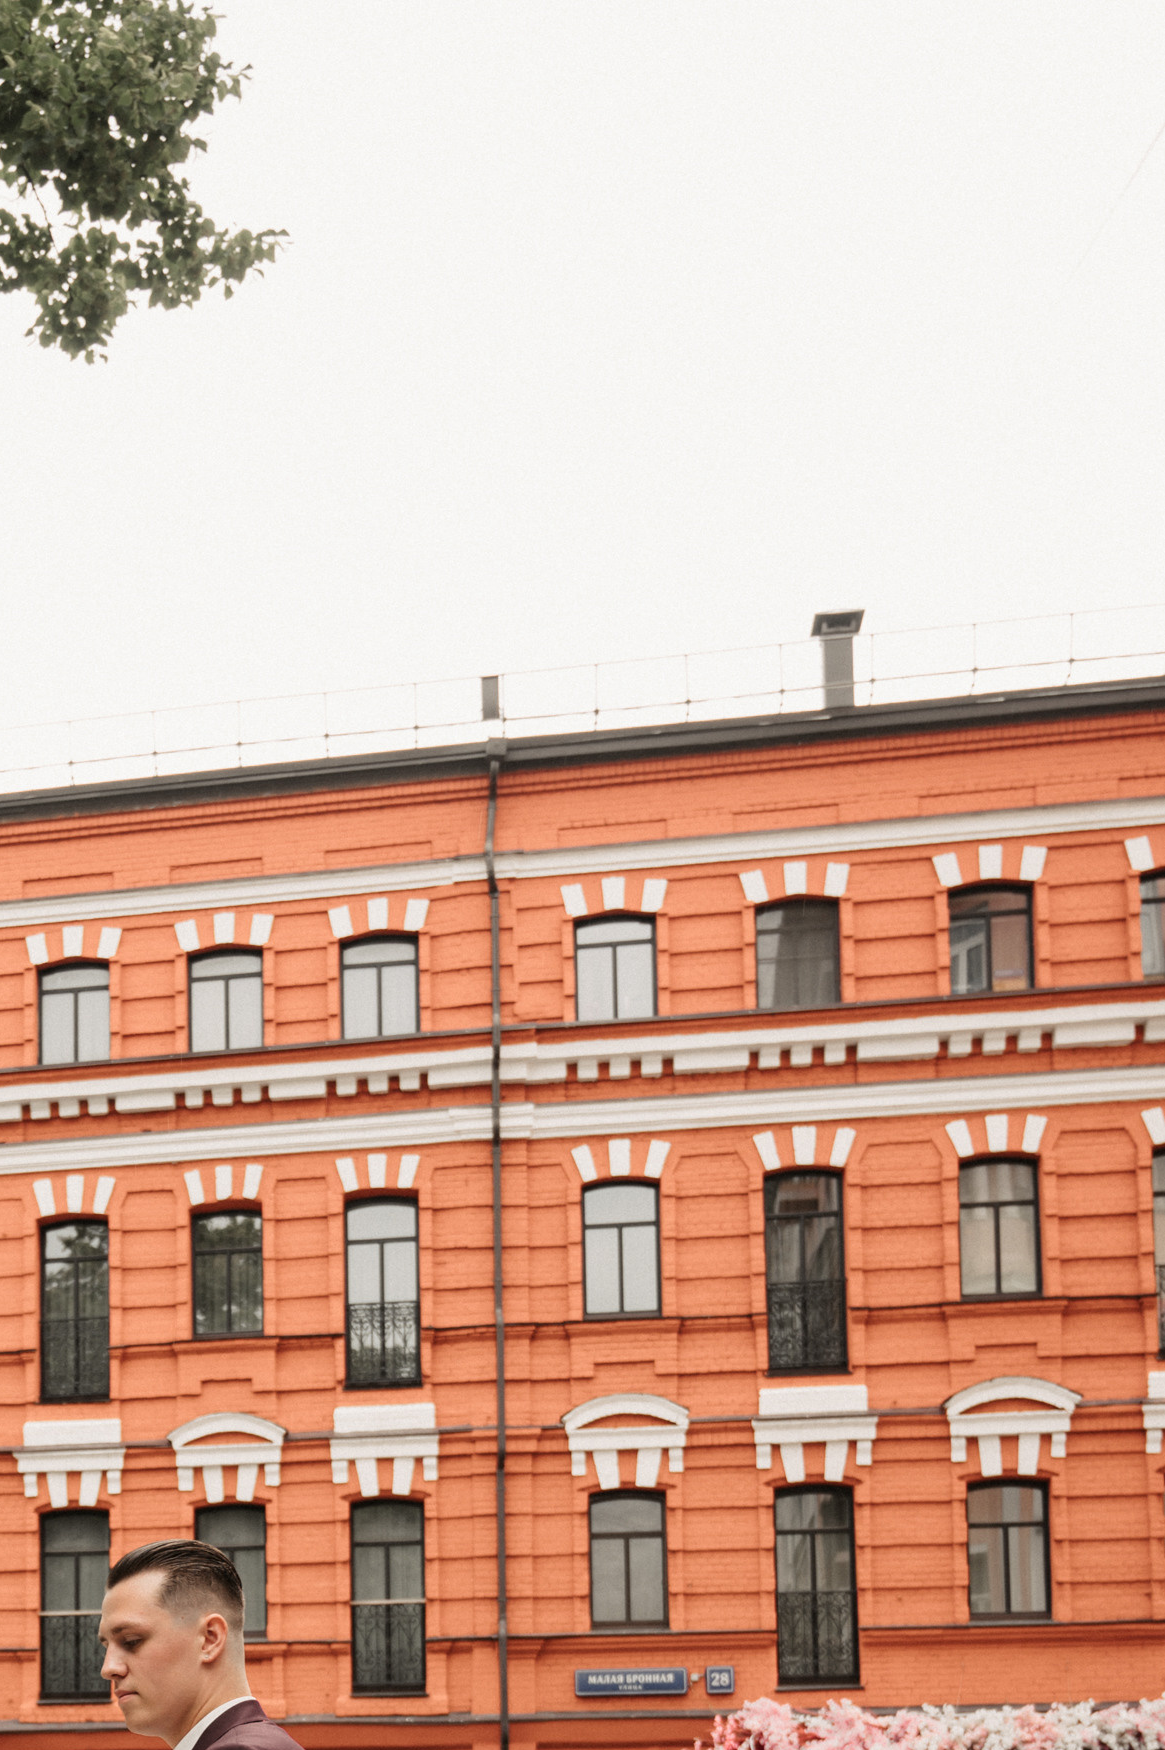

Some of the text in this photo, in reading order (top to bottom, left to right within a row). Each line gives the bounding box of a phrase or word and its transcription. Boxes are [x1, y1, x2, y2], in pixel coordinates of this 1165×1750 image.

[588, 1673, 675, 1684] МАЛАЯ БРОННАЯ
[710, 1672, 730, 1687] 28
